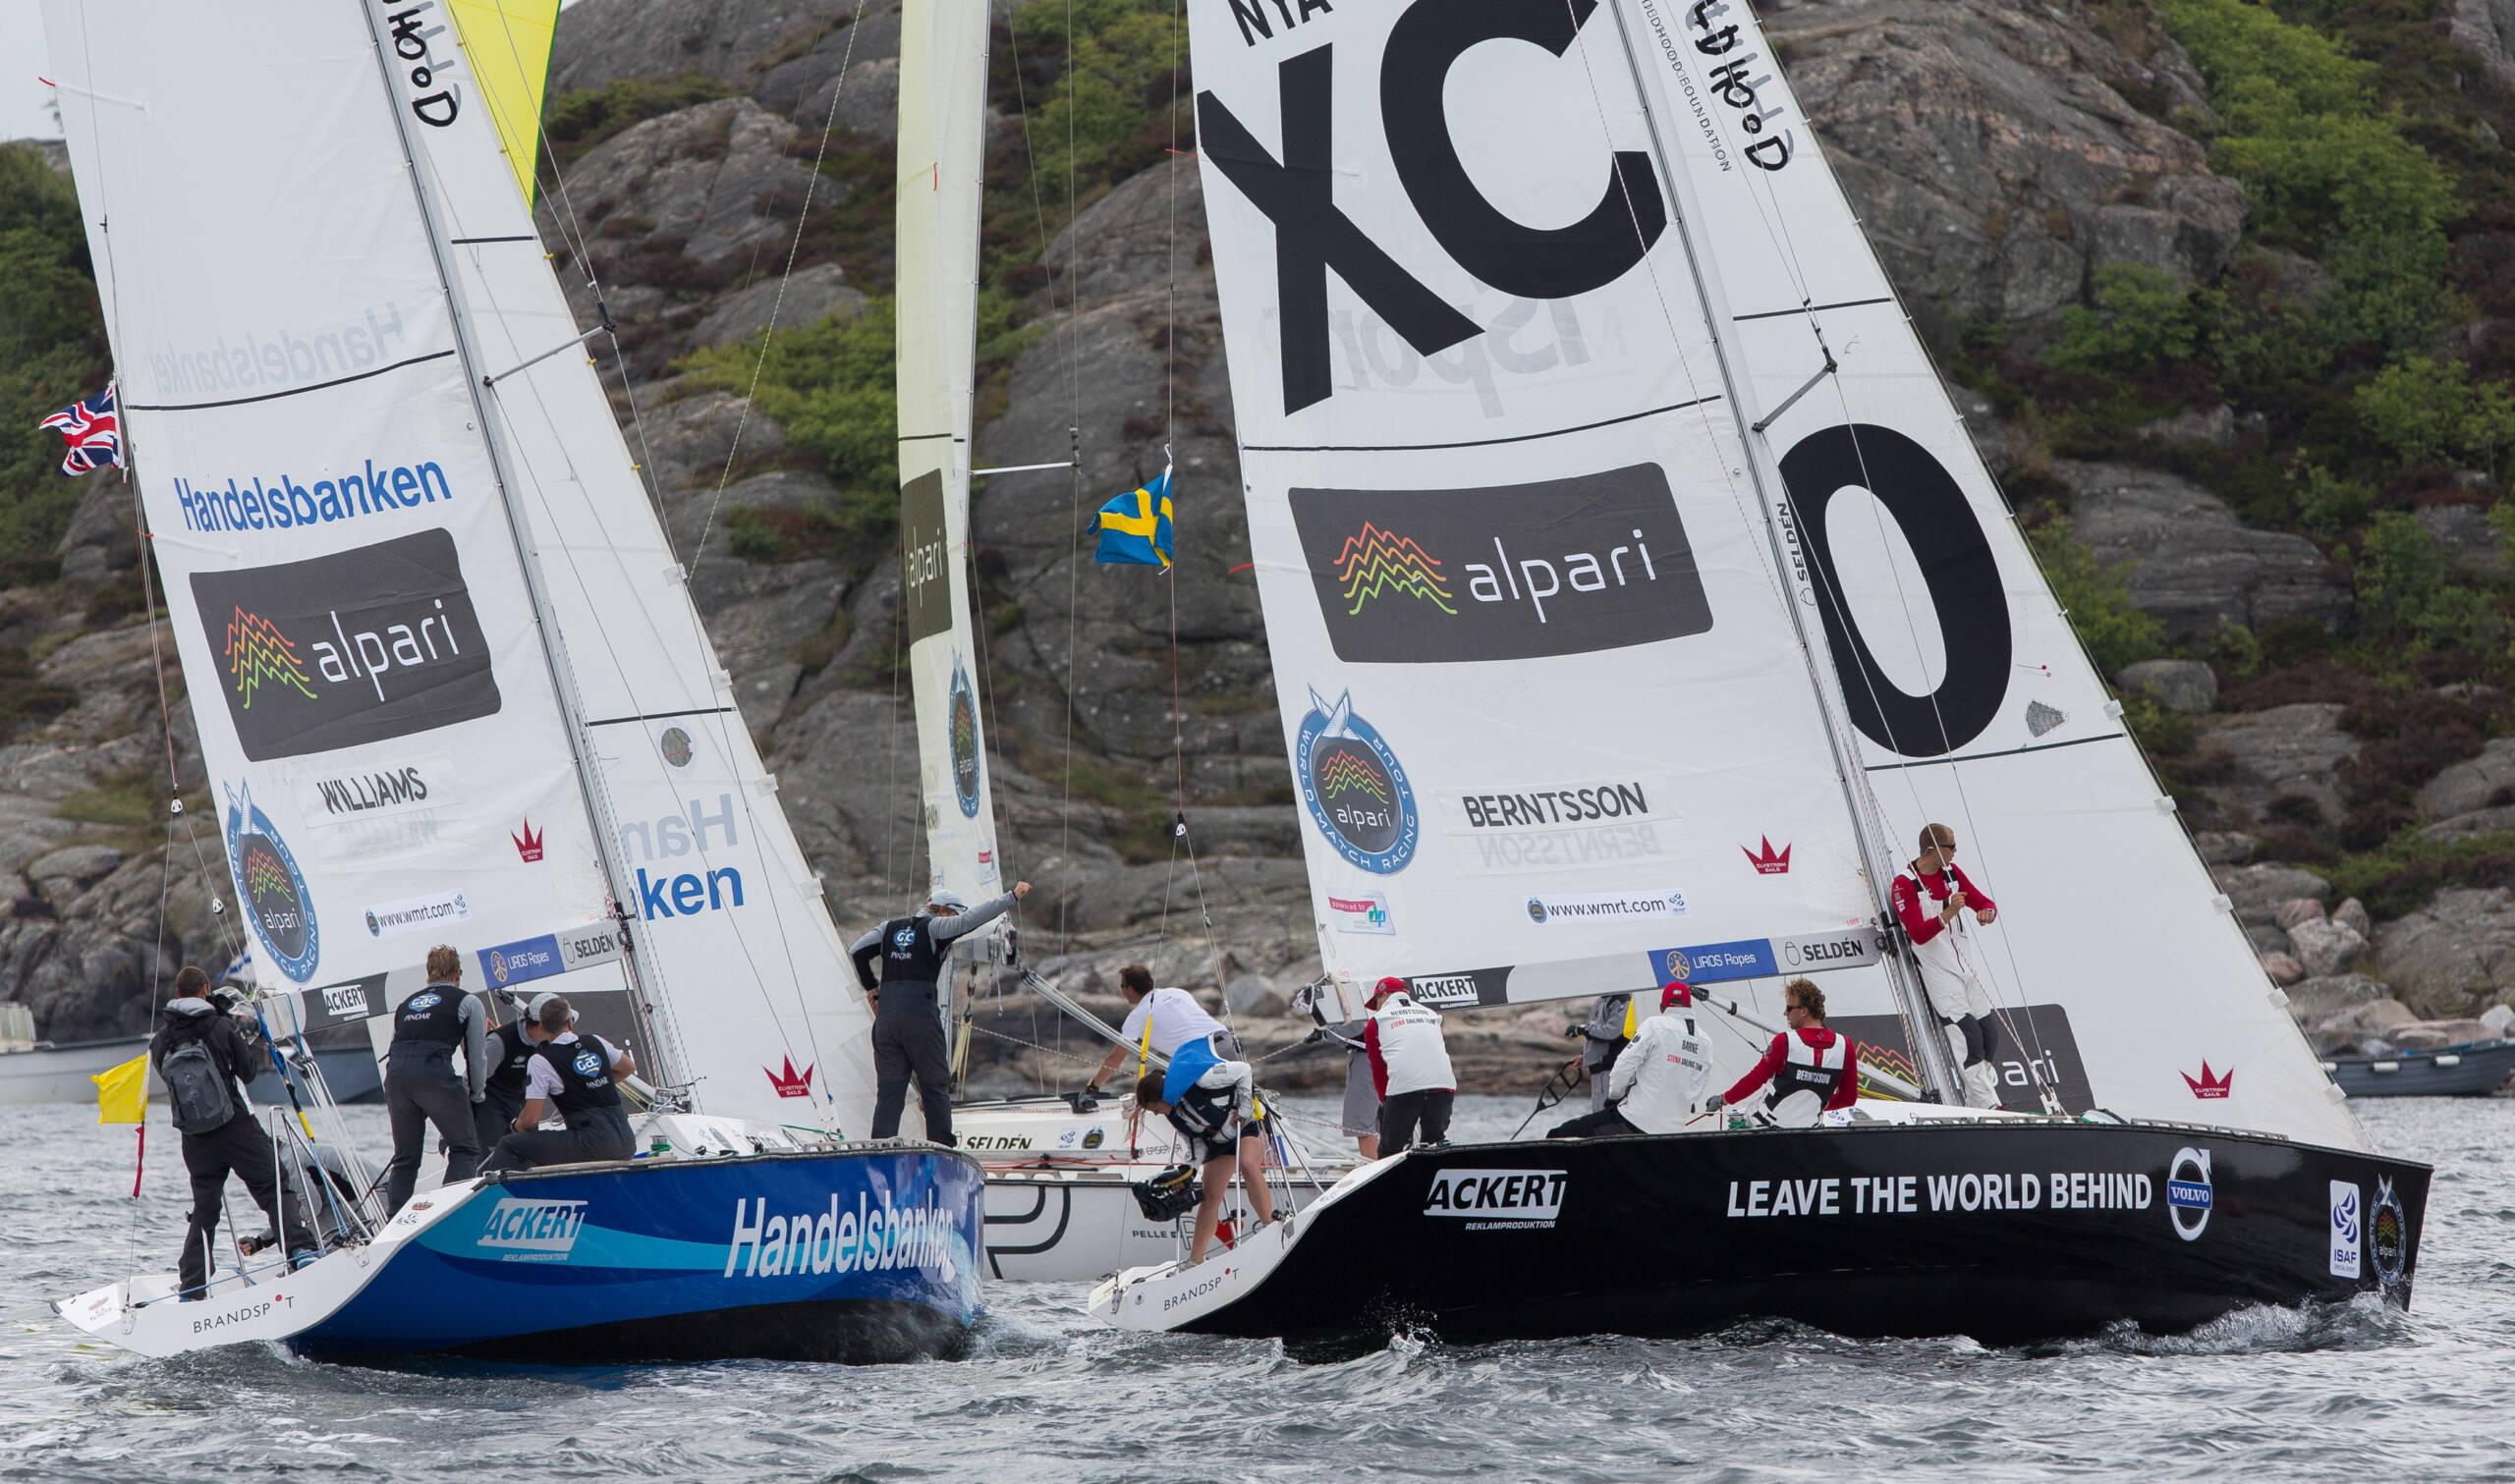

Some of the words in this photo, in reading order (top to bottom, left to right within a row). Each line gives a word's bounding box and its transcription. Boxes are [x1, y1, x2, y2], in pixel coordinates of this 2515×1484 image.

[174, 459, 452, 532] Handelsbanken
[909, 526, 943, 608] alpari
[1465, 529, 1657, 624] alpari
[311, 599, 460, 701] alpari
[1299, 729, 1315, 802] WORLD
[1372, 738, 1409, 799] TOUR
[316, 767, 428, 814] WILLIAMS
[1462, 782, 1649, 828] BERNTSSON
[1336, 803, 1391, 833] alpari
[1315, 812, 1371, 868] MATCH
[1381, 813, 1415, 870] RACING
[630, 866, 745, 922] ken
[1546, 898, 1666, 917] www.wmrt.com
[264, 907, 301, 936] alpari
[377, 900, 455, 928] www.wmrt.com
[253, 919, 296, 975] MATCH
[301, 909, 318, 976] RACING
[575, 931, 616, 959] SELDÉN
[1693, 953, 1724, 969] LIROS
[1725, 952, 1757, 967] Ropes
[1803, 937, 1865, 962] SELDÉN
[324, 985, 366, 1013] ACKERT
[1415, 977, 1477, 1000] ACKERT
[1424, 1172, 1569, 1211] ACKERT
[1727, 1179, 1841, 1218] LEAVE
[1851, 1176, 1918, 1214] THE
[1927, 1173, 2041, 1212] WORLD
[2050, 1172, 2152, 1210] BEHIND
[2170, 1185, 2209, 1203] VOLVO
[479, 1202, 587, 1241] ACKERT
[724, 1187, 954, 1279] Handelsbanken
[1132, 1230, 1168, 1238] PELLE
[1465, 1220, 1556, 1231] REKLAMPRODUKTION
[2333, 1248, 2357, 1264] ISAF
